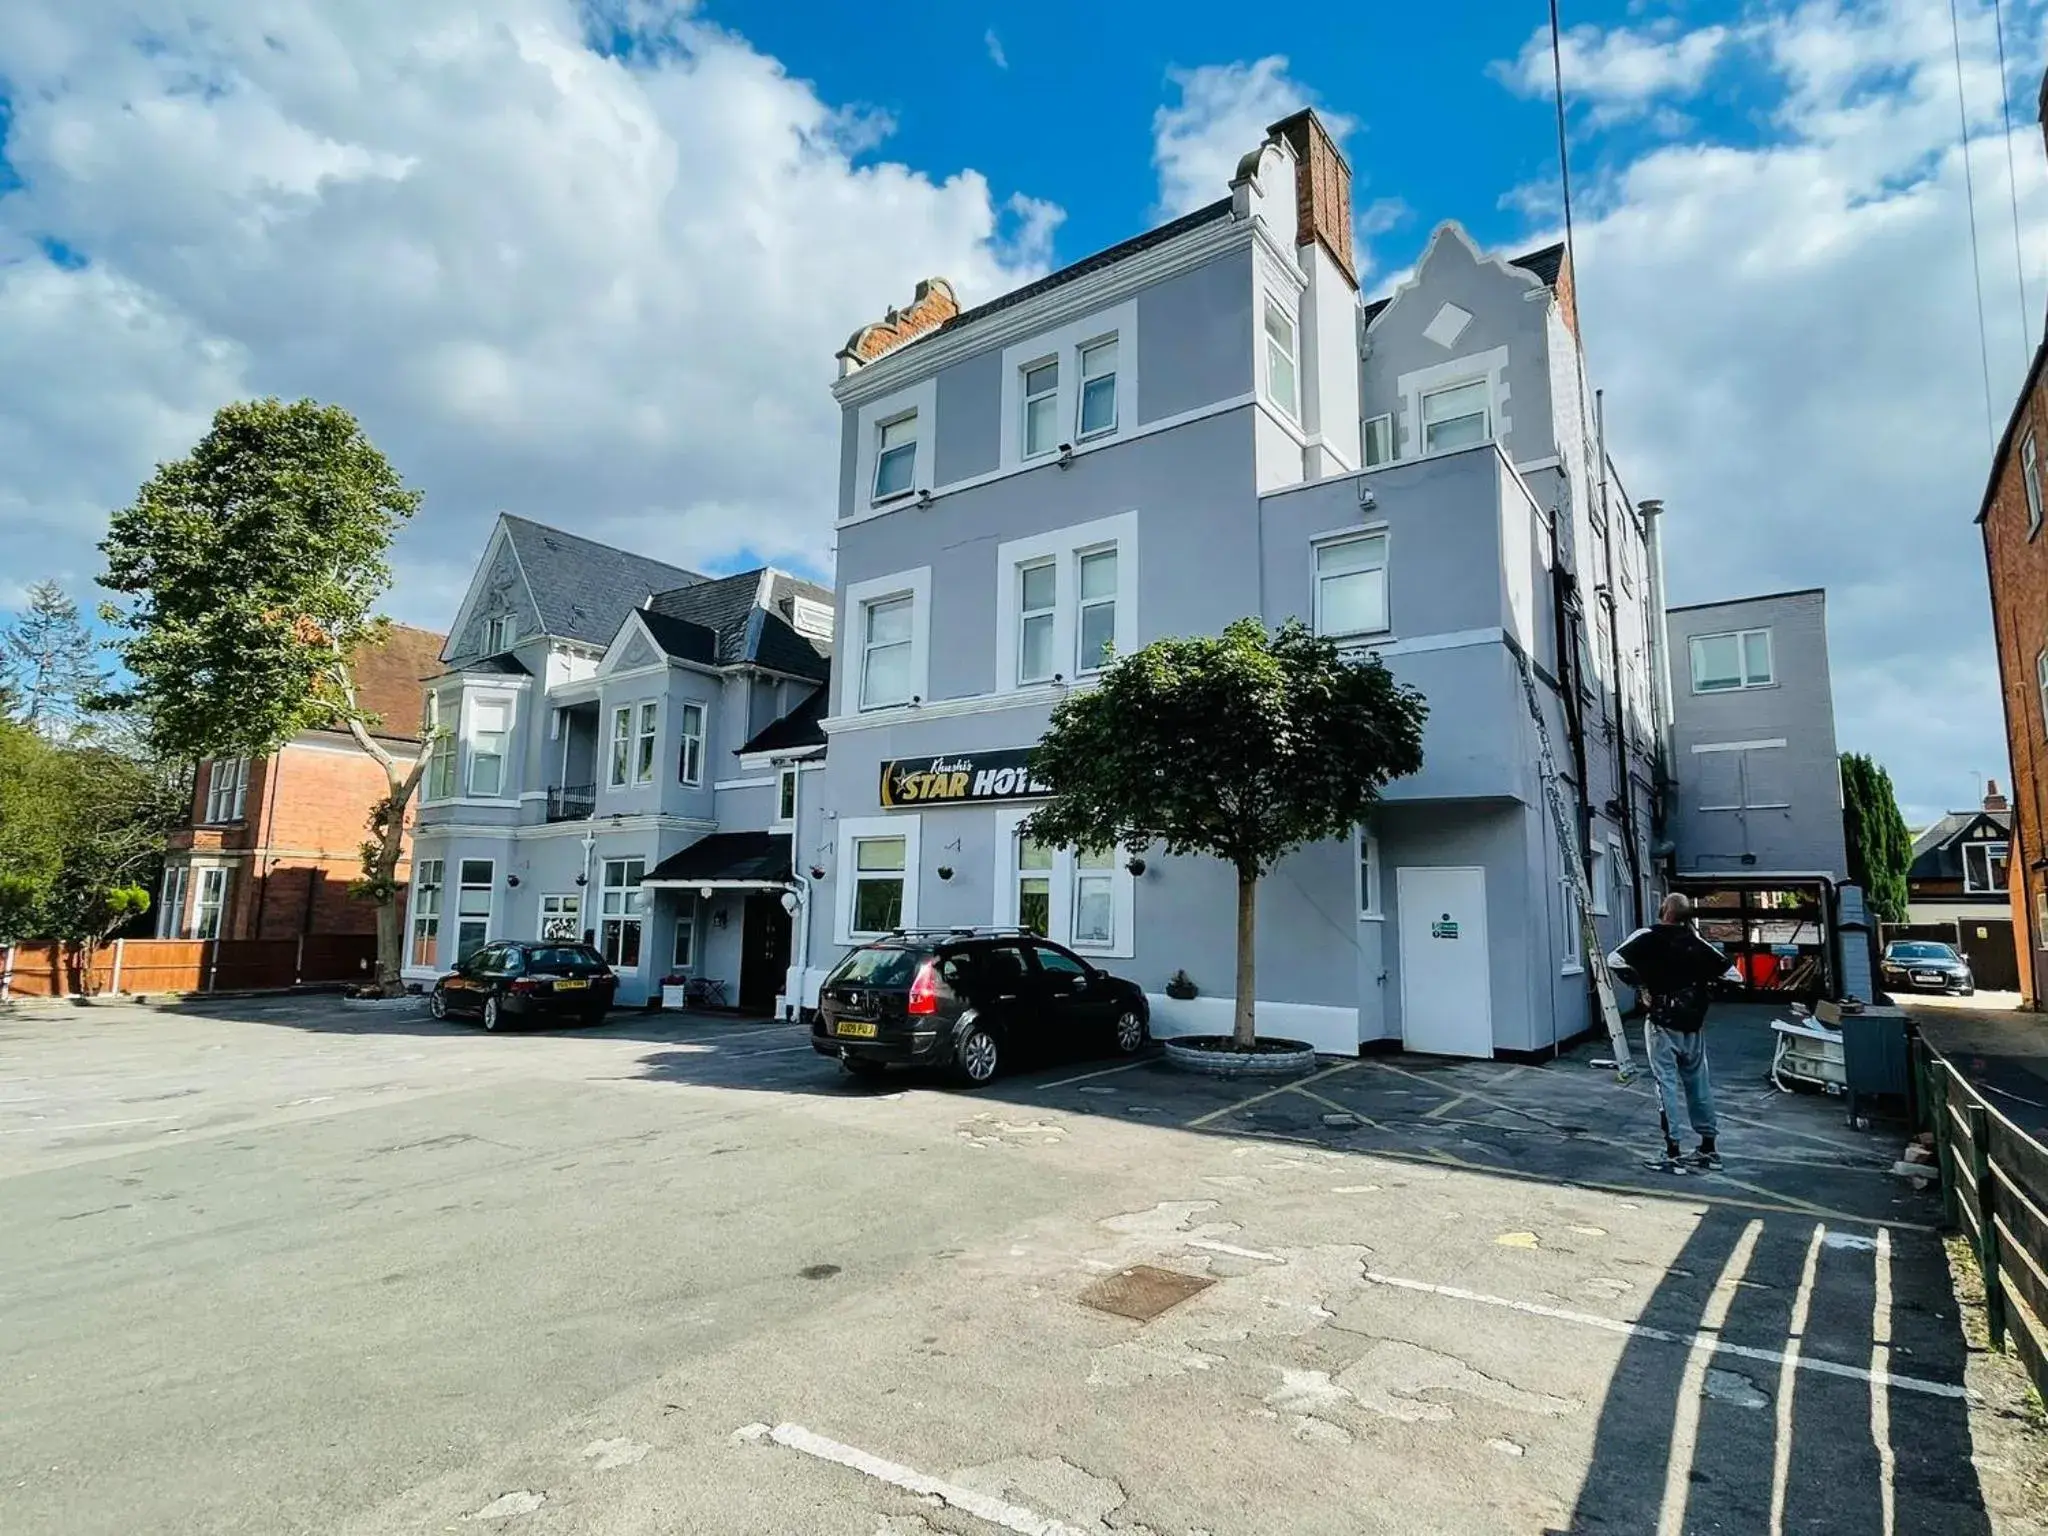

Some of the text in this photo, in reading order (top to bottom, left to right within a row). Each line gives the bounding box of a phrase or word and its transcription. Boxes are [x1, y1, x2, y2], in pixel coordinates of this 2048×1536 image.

[930, 757, 973, 774] Khushi's
[902, 767, 1054, 800] STAR HOTE
